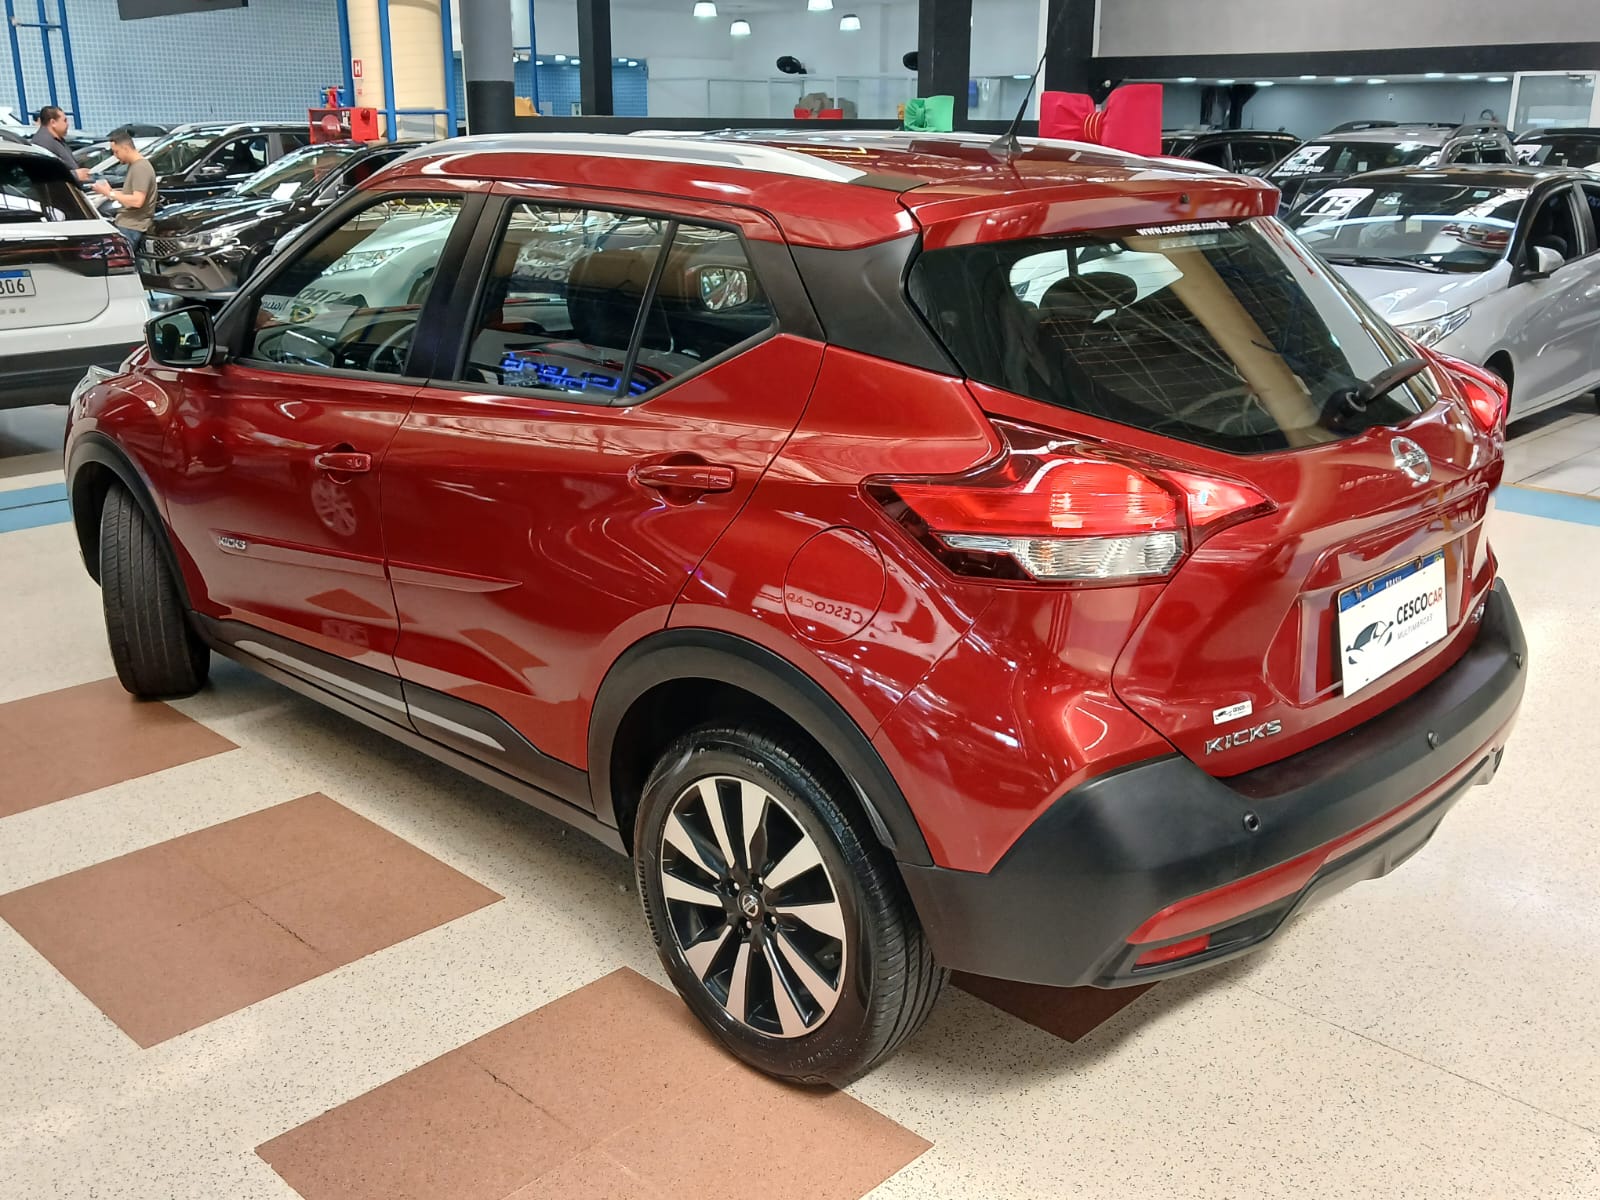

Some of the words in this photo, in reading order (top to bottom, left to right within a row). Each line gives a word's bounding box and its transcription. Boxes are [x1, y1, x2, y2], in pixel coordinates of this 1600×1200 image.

[1319, 197, 1359, 213] 19
[1396, 587, 1443, 625] CESCOCAR
[1205, 720, 1282, 755] KICKS
